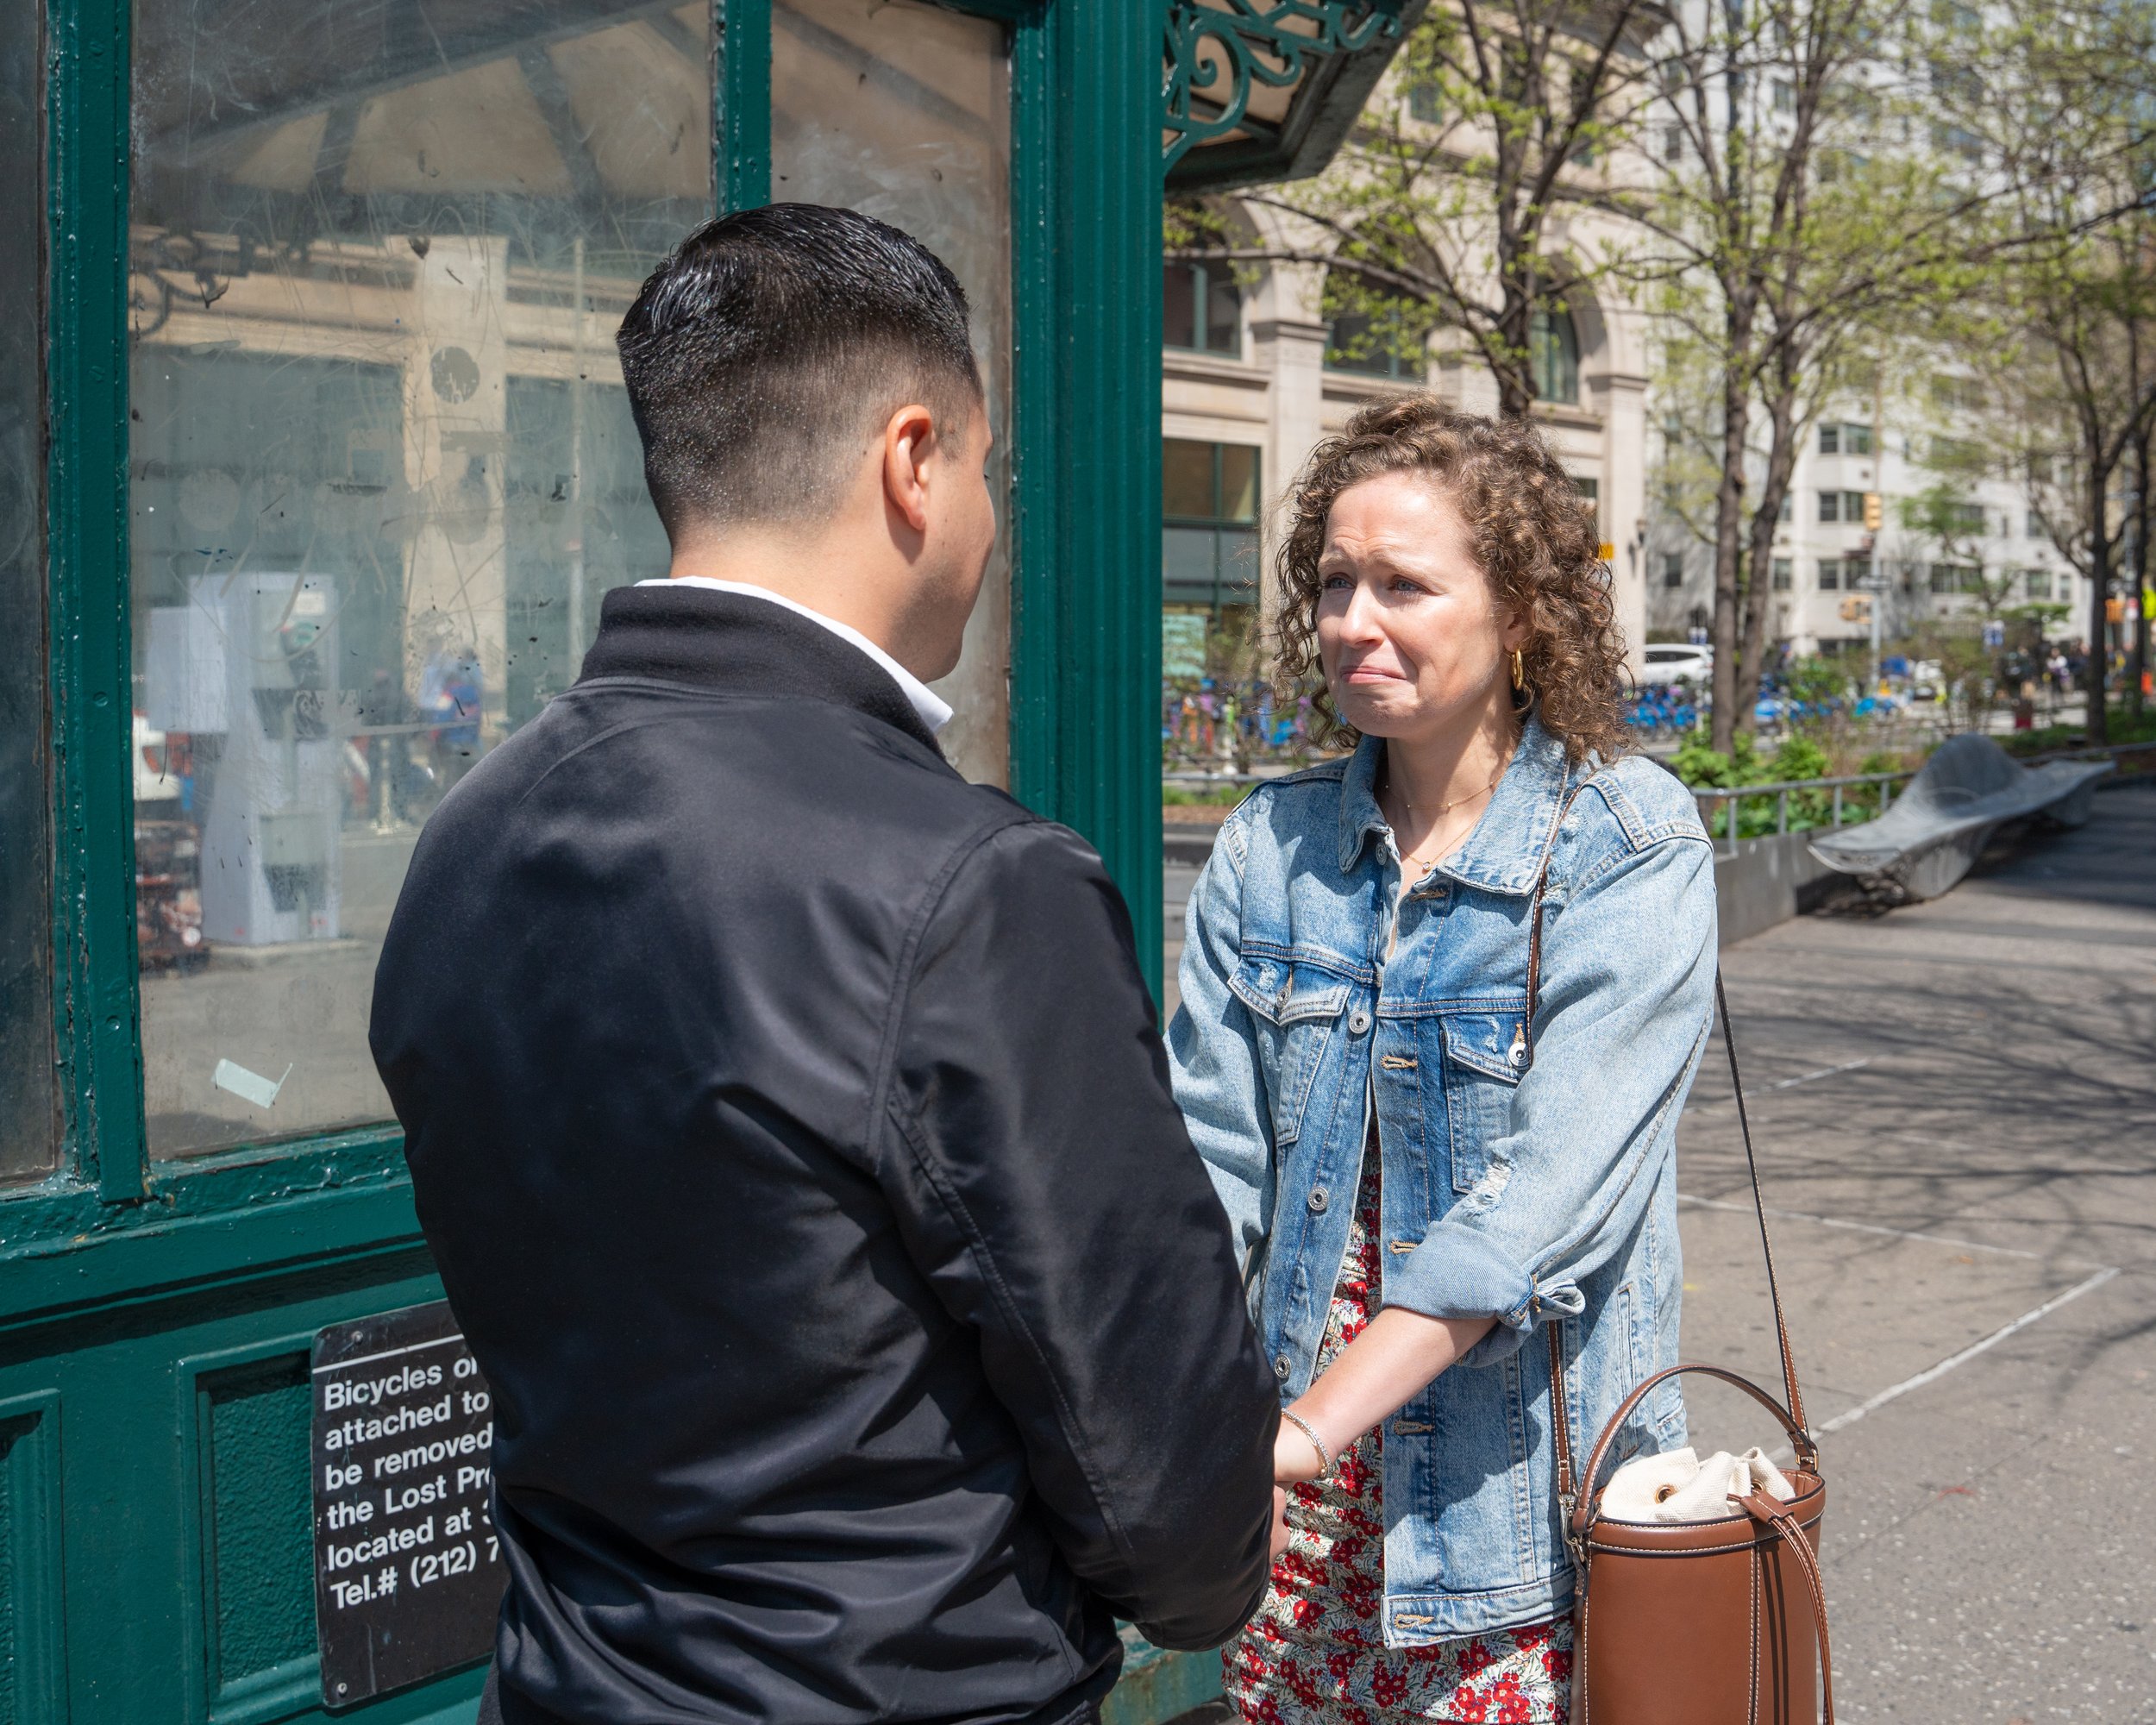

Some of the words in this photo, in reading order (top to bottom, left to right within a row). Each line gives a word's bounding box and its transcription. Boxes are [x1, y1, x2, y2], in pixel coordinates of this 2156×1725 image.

[324, 1365, 442, 1411] Bicycles
[325, 1394, 451, 1451] attached
[461, 1390, 490, 1414] to
[325, 1464, 363, 1491] be
[374, 1421, 493, 1478] removed
[327, 1500, 374, 1530] the
[385, 1474, 447, 1515] Lost
[327, 1515, 435, 1571] located
[445, 1506, 472, 1536] at
[329, 1565, 398, 1610] Tel.#
[411, 1540, 477, 1588] (212)
